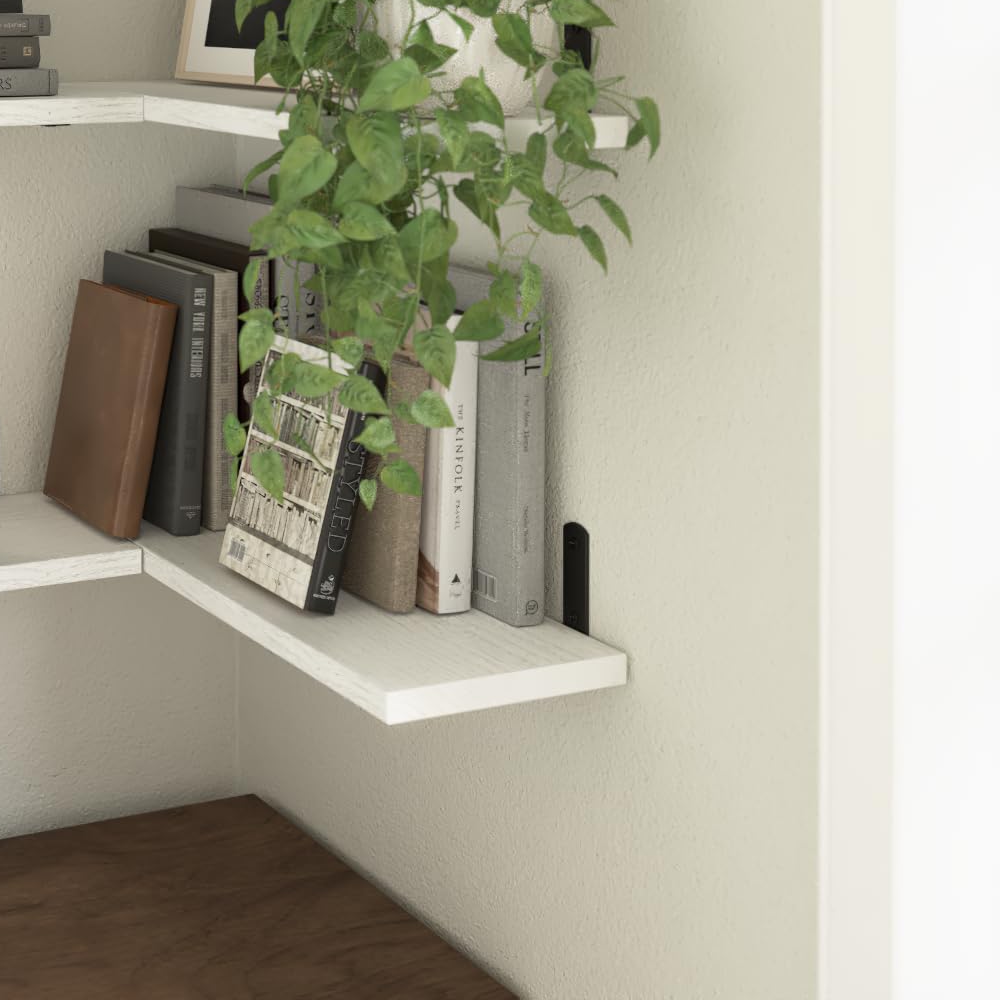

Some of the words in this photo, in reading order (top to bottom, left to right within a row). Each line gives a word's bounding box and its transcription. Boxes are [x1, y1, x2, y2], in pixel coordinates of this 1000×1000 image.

[193, 287, 207, 306] NEW
[192, 312, 206, 332] YORK
[190, 338, 204, 378] INTERIORS
[524, 321, 541, 376] SLL
[453, 427, 465, 494] KINFOLK
